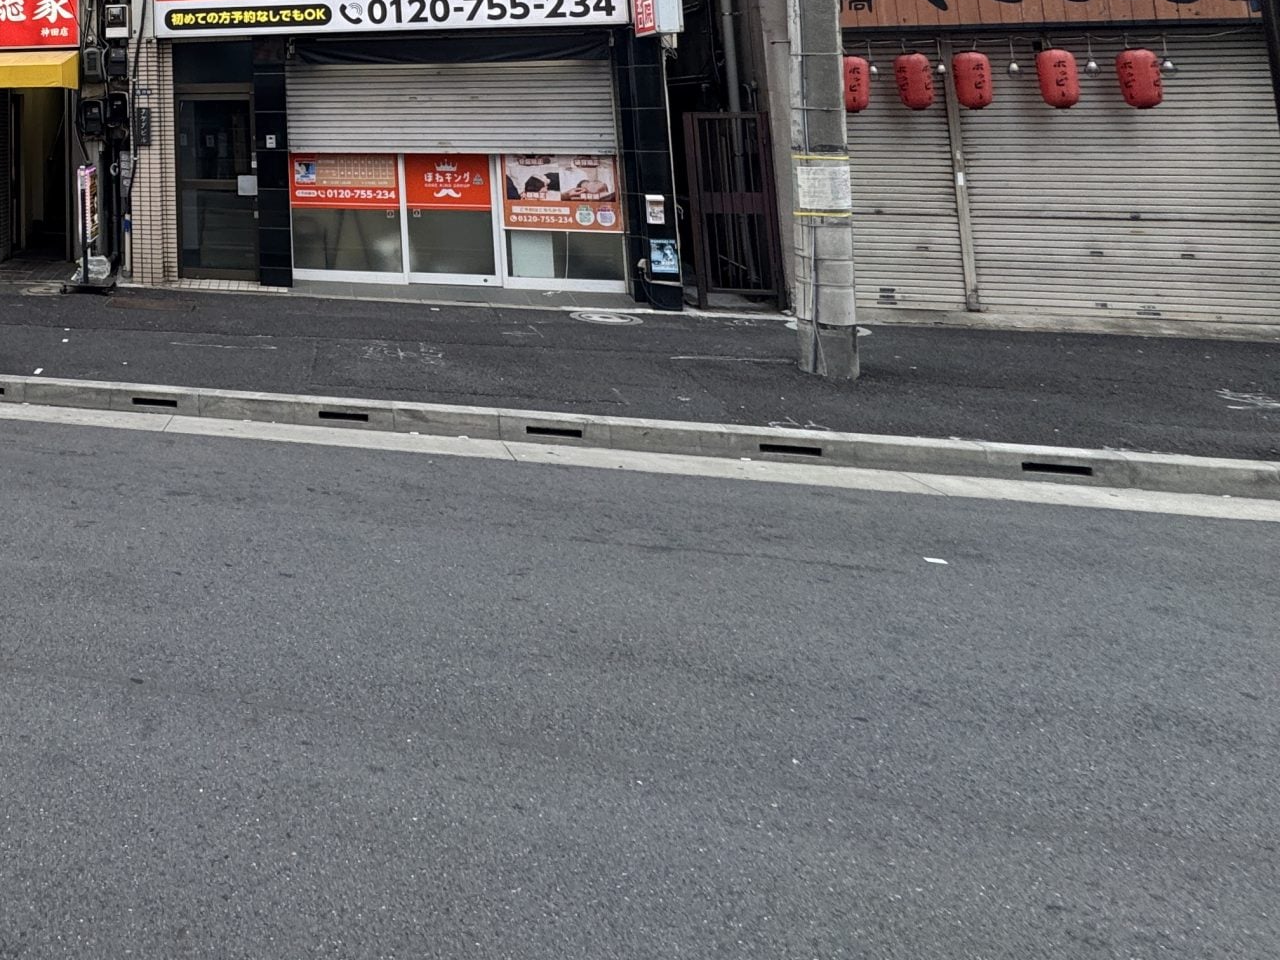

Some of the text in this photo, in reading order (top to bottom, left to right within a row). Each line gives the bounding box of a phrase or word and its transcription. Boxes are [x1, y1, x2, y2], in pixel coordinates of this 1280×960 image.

[171, 8, 327, 26] 初めての方予約なしでもOK
[40, 25, 69, 38] 神田店
[423, 172, 470, 183] ほねキング
[326, 189, 396, 199] 0120-755-234
[518, 214, 573, 224] 0120-755-234
